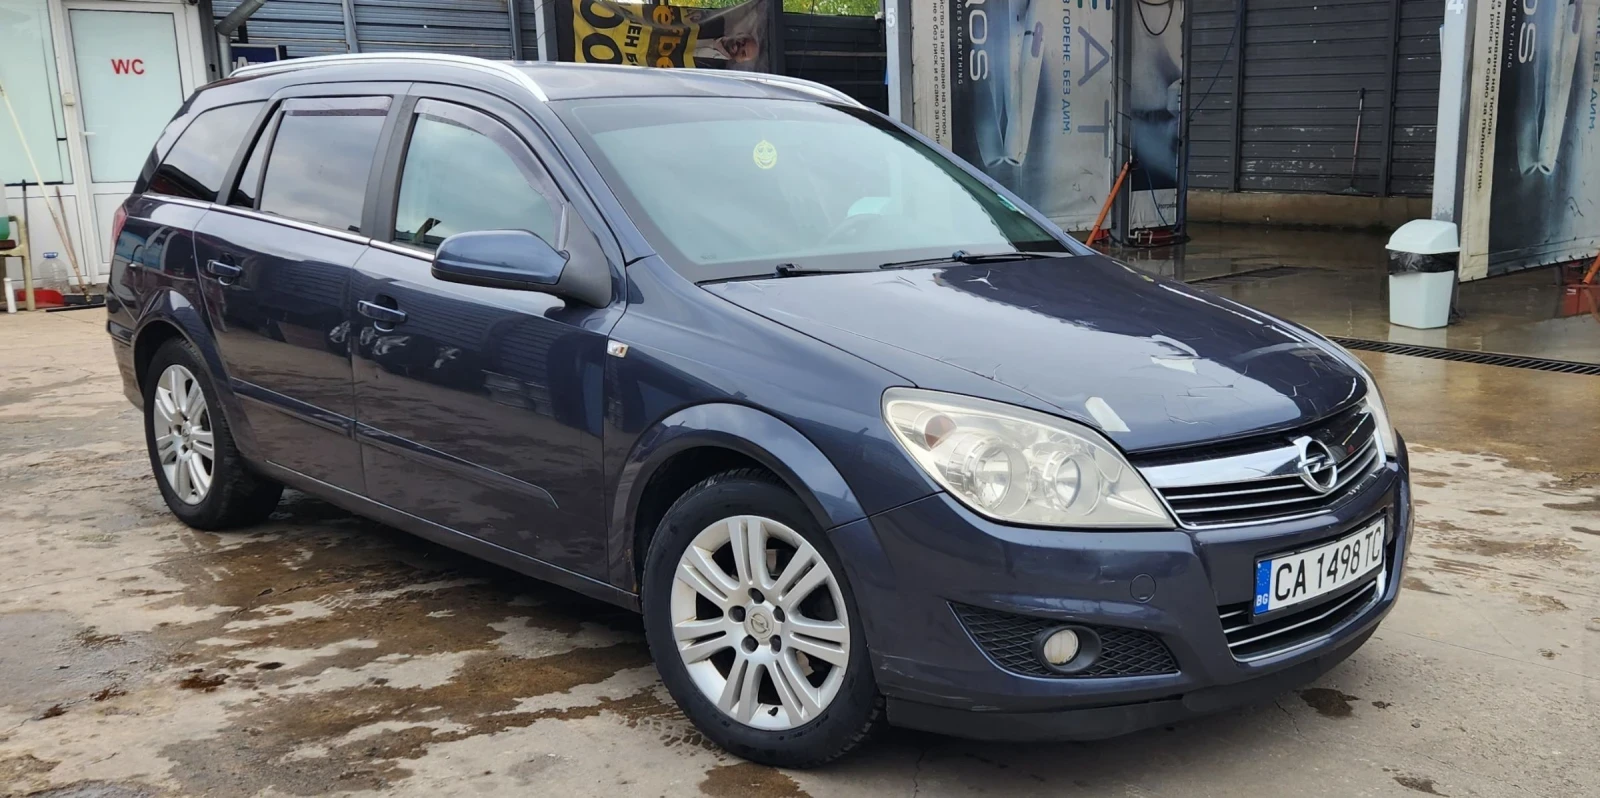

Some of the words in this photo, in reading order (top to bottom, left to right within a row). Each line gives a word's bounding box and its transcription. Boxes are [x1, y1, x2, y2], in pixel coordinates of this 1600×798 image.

[885, 7, 896, 28] 5
[1447, 0, 1464, 14] 4
[1062, 8, 1071, 65] ГОРЕНЕ.
[110, 58, 145, 75] WC
[1062, 69, 1071, 95] БЕЗ
[1061, 99, 1071, 135] ДИМ.
[1588, 88, 1598, 134] ДИМ.
[1275, 559, 1307, 601] CA
[1317, 539, 1361, 589] 1498
[1365, 526, 1382, 568] TC
[1256, 593, 1269, 607] BG
